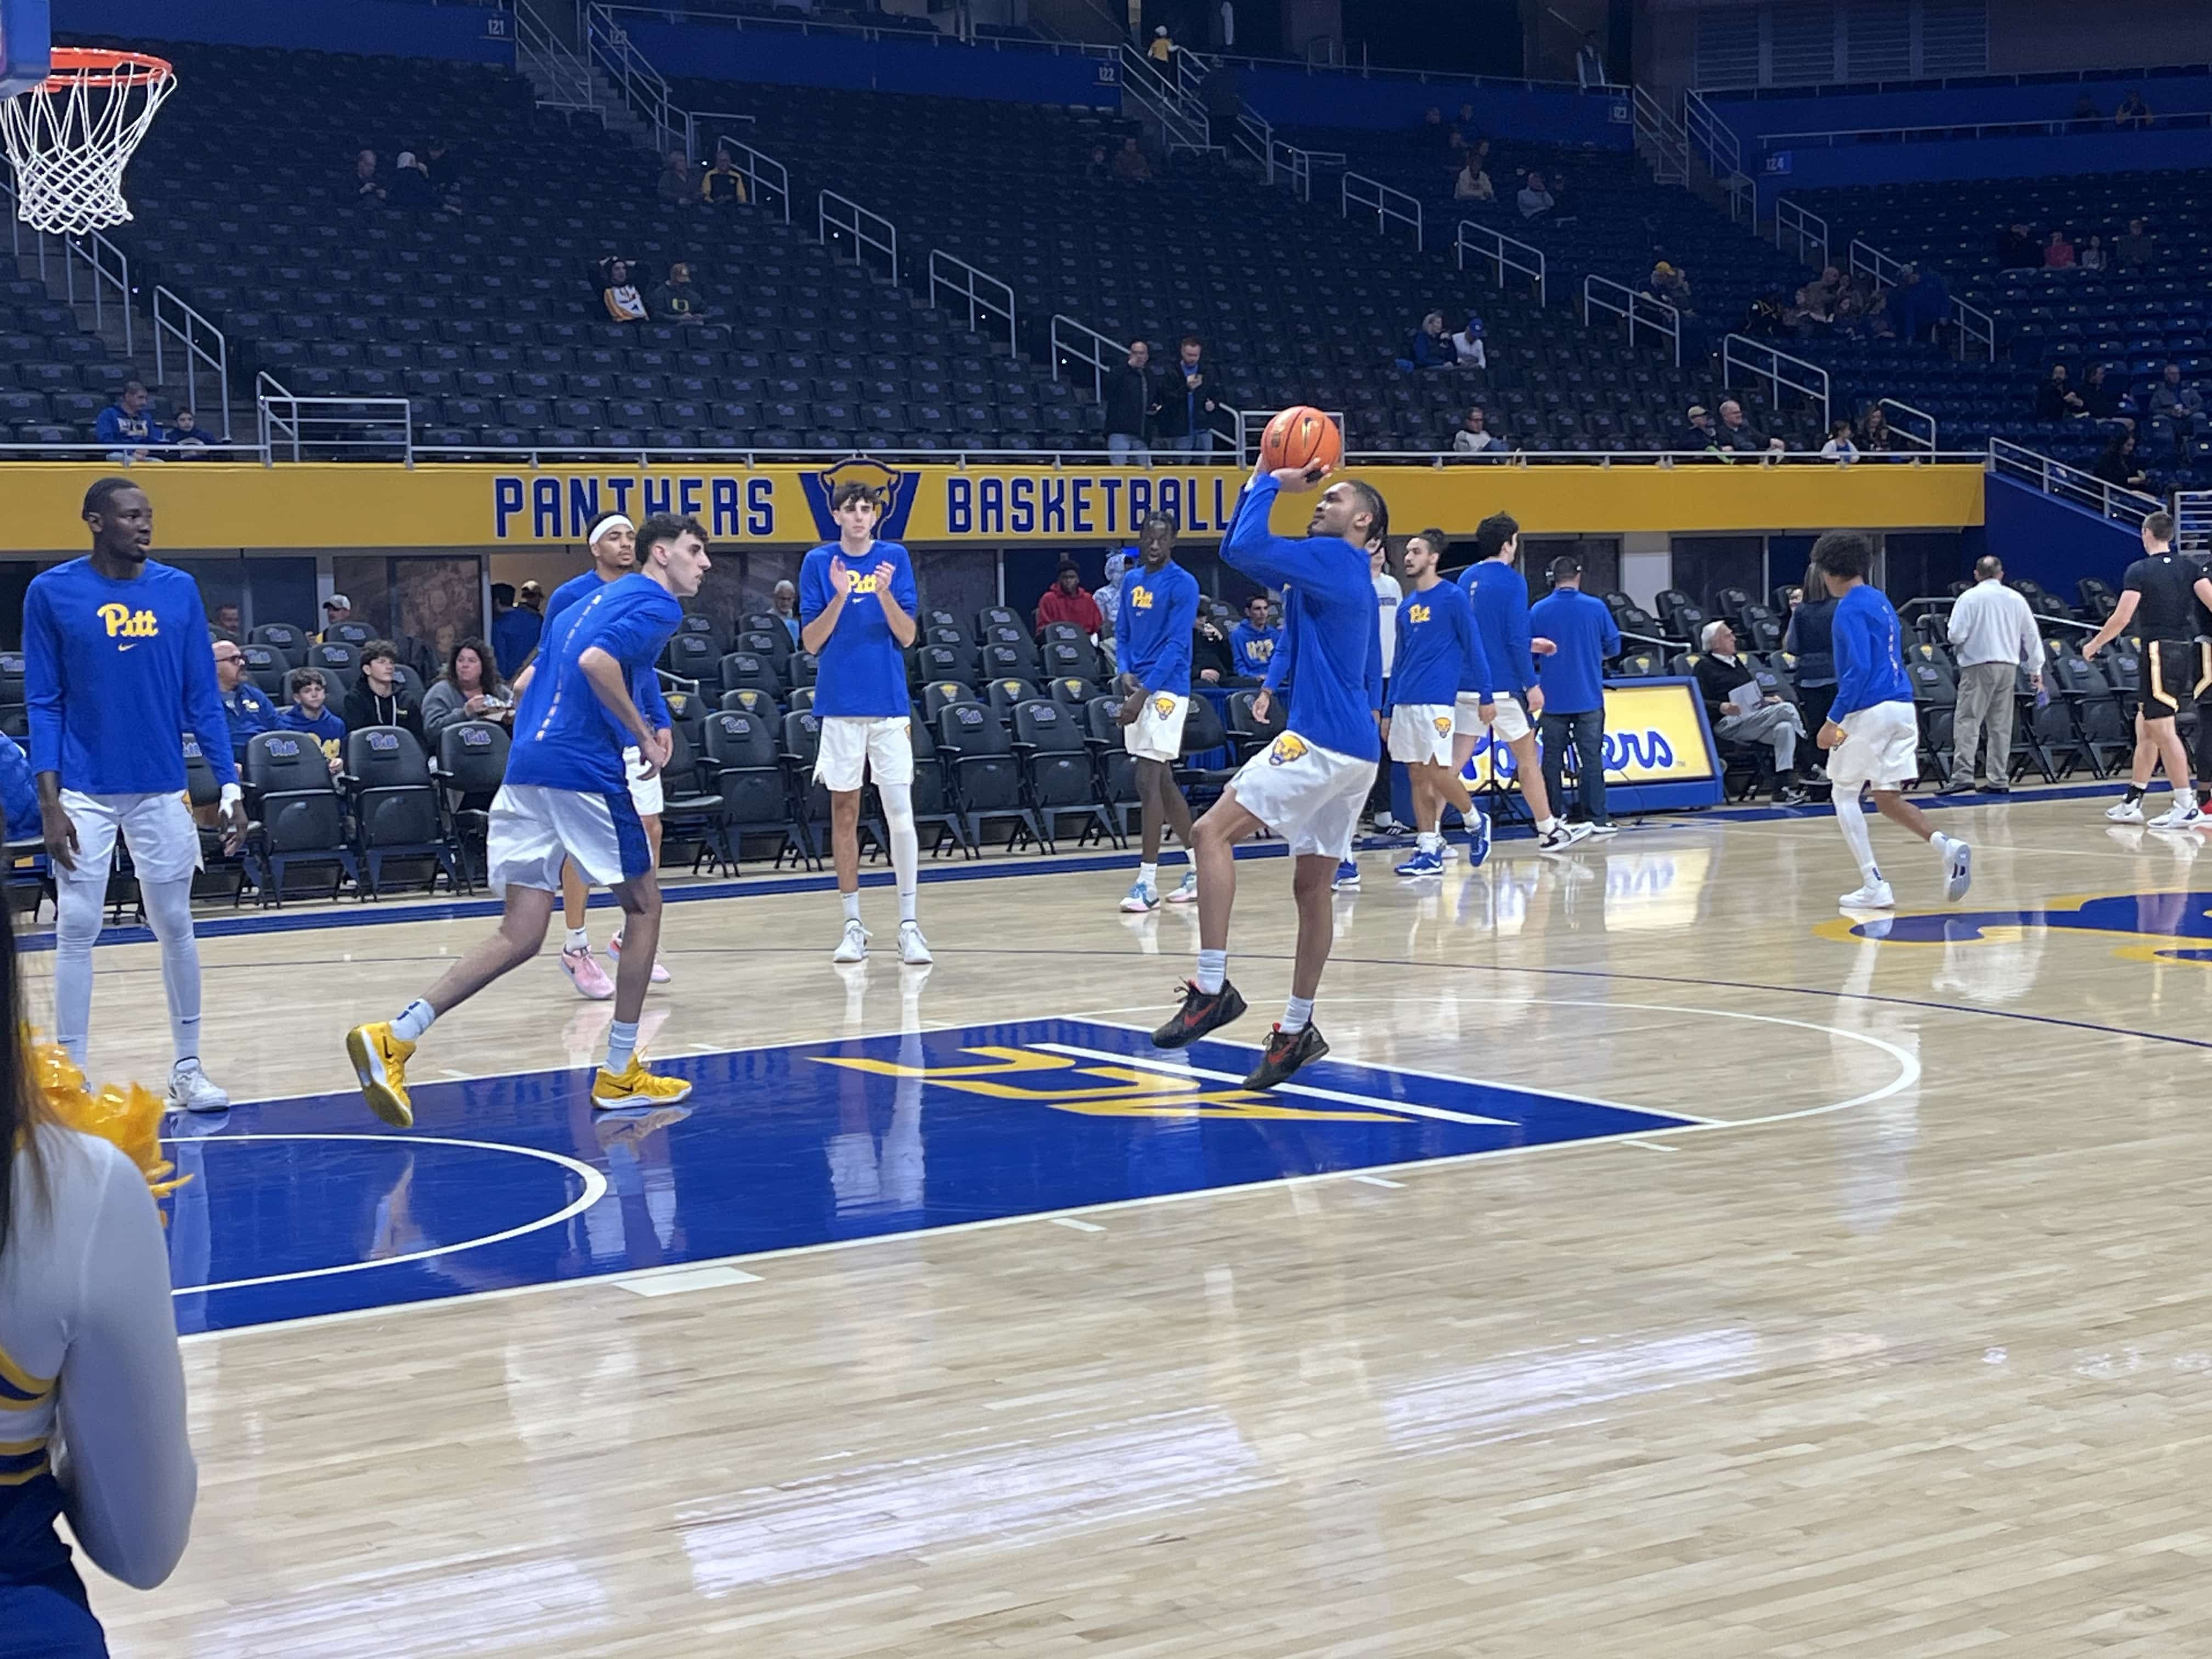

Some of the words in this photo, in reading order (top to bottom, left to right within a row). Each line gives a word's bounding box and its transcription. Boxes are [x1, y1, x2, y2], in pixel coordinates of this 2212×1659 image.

[488, 19, 504, 35] 121
[494, 477, 774, 537] PANTHERS
[947, 477, 1229, 532] BASKETBALL
[97, 602, 159, 637] Pitt
